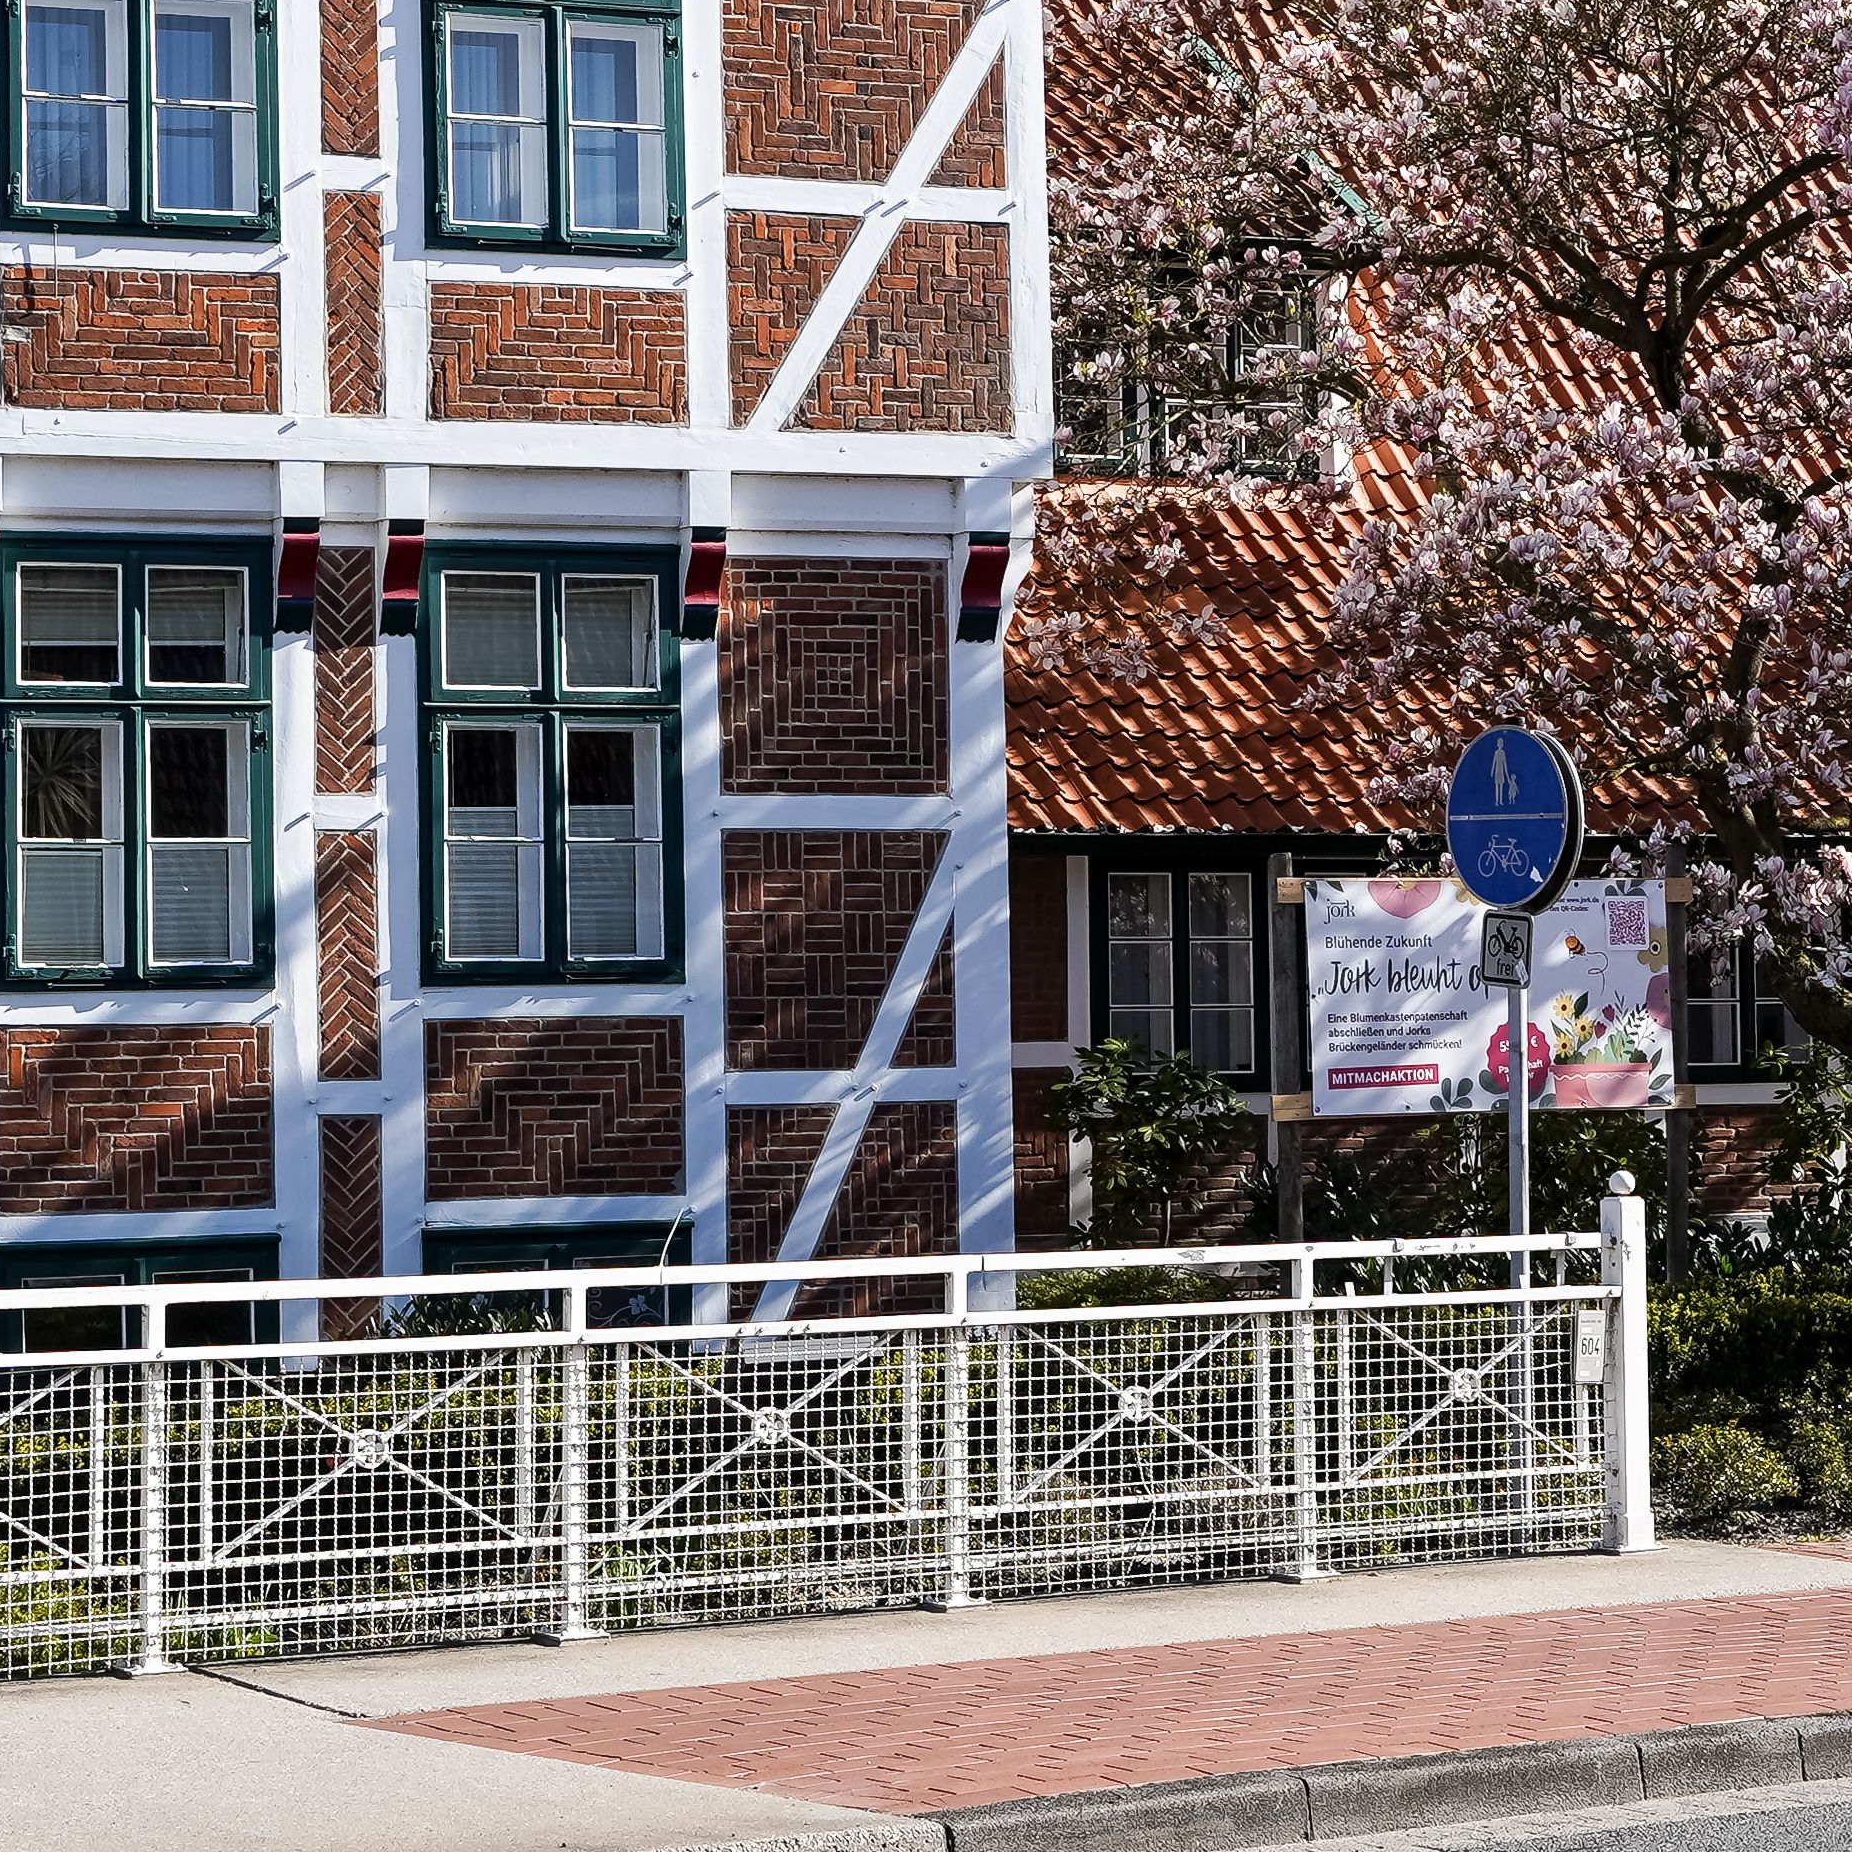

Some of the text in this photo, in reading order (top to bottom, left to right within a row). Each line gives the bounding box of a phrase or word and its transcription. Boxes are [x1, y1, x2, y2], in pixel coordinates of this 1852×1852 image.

[1323, 898, 1356, 924] jork
[1326, 934, 1433, 949] Blühende Zukunft
[1496, 958, 1514, 976] frei
[1327, 1010, 1468, 1025] Eine Blumenkastenpatenschaft
[1328, 1025, 1431, 1038] abschließen und Jorks
[1329, 1038, 1462, 1053] Brückengeländer schmücken!
[1332, 1068, 1434, 1085] MITMACHAKTION
[1581, 1337, 1600, 1355] 604
